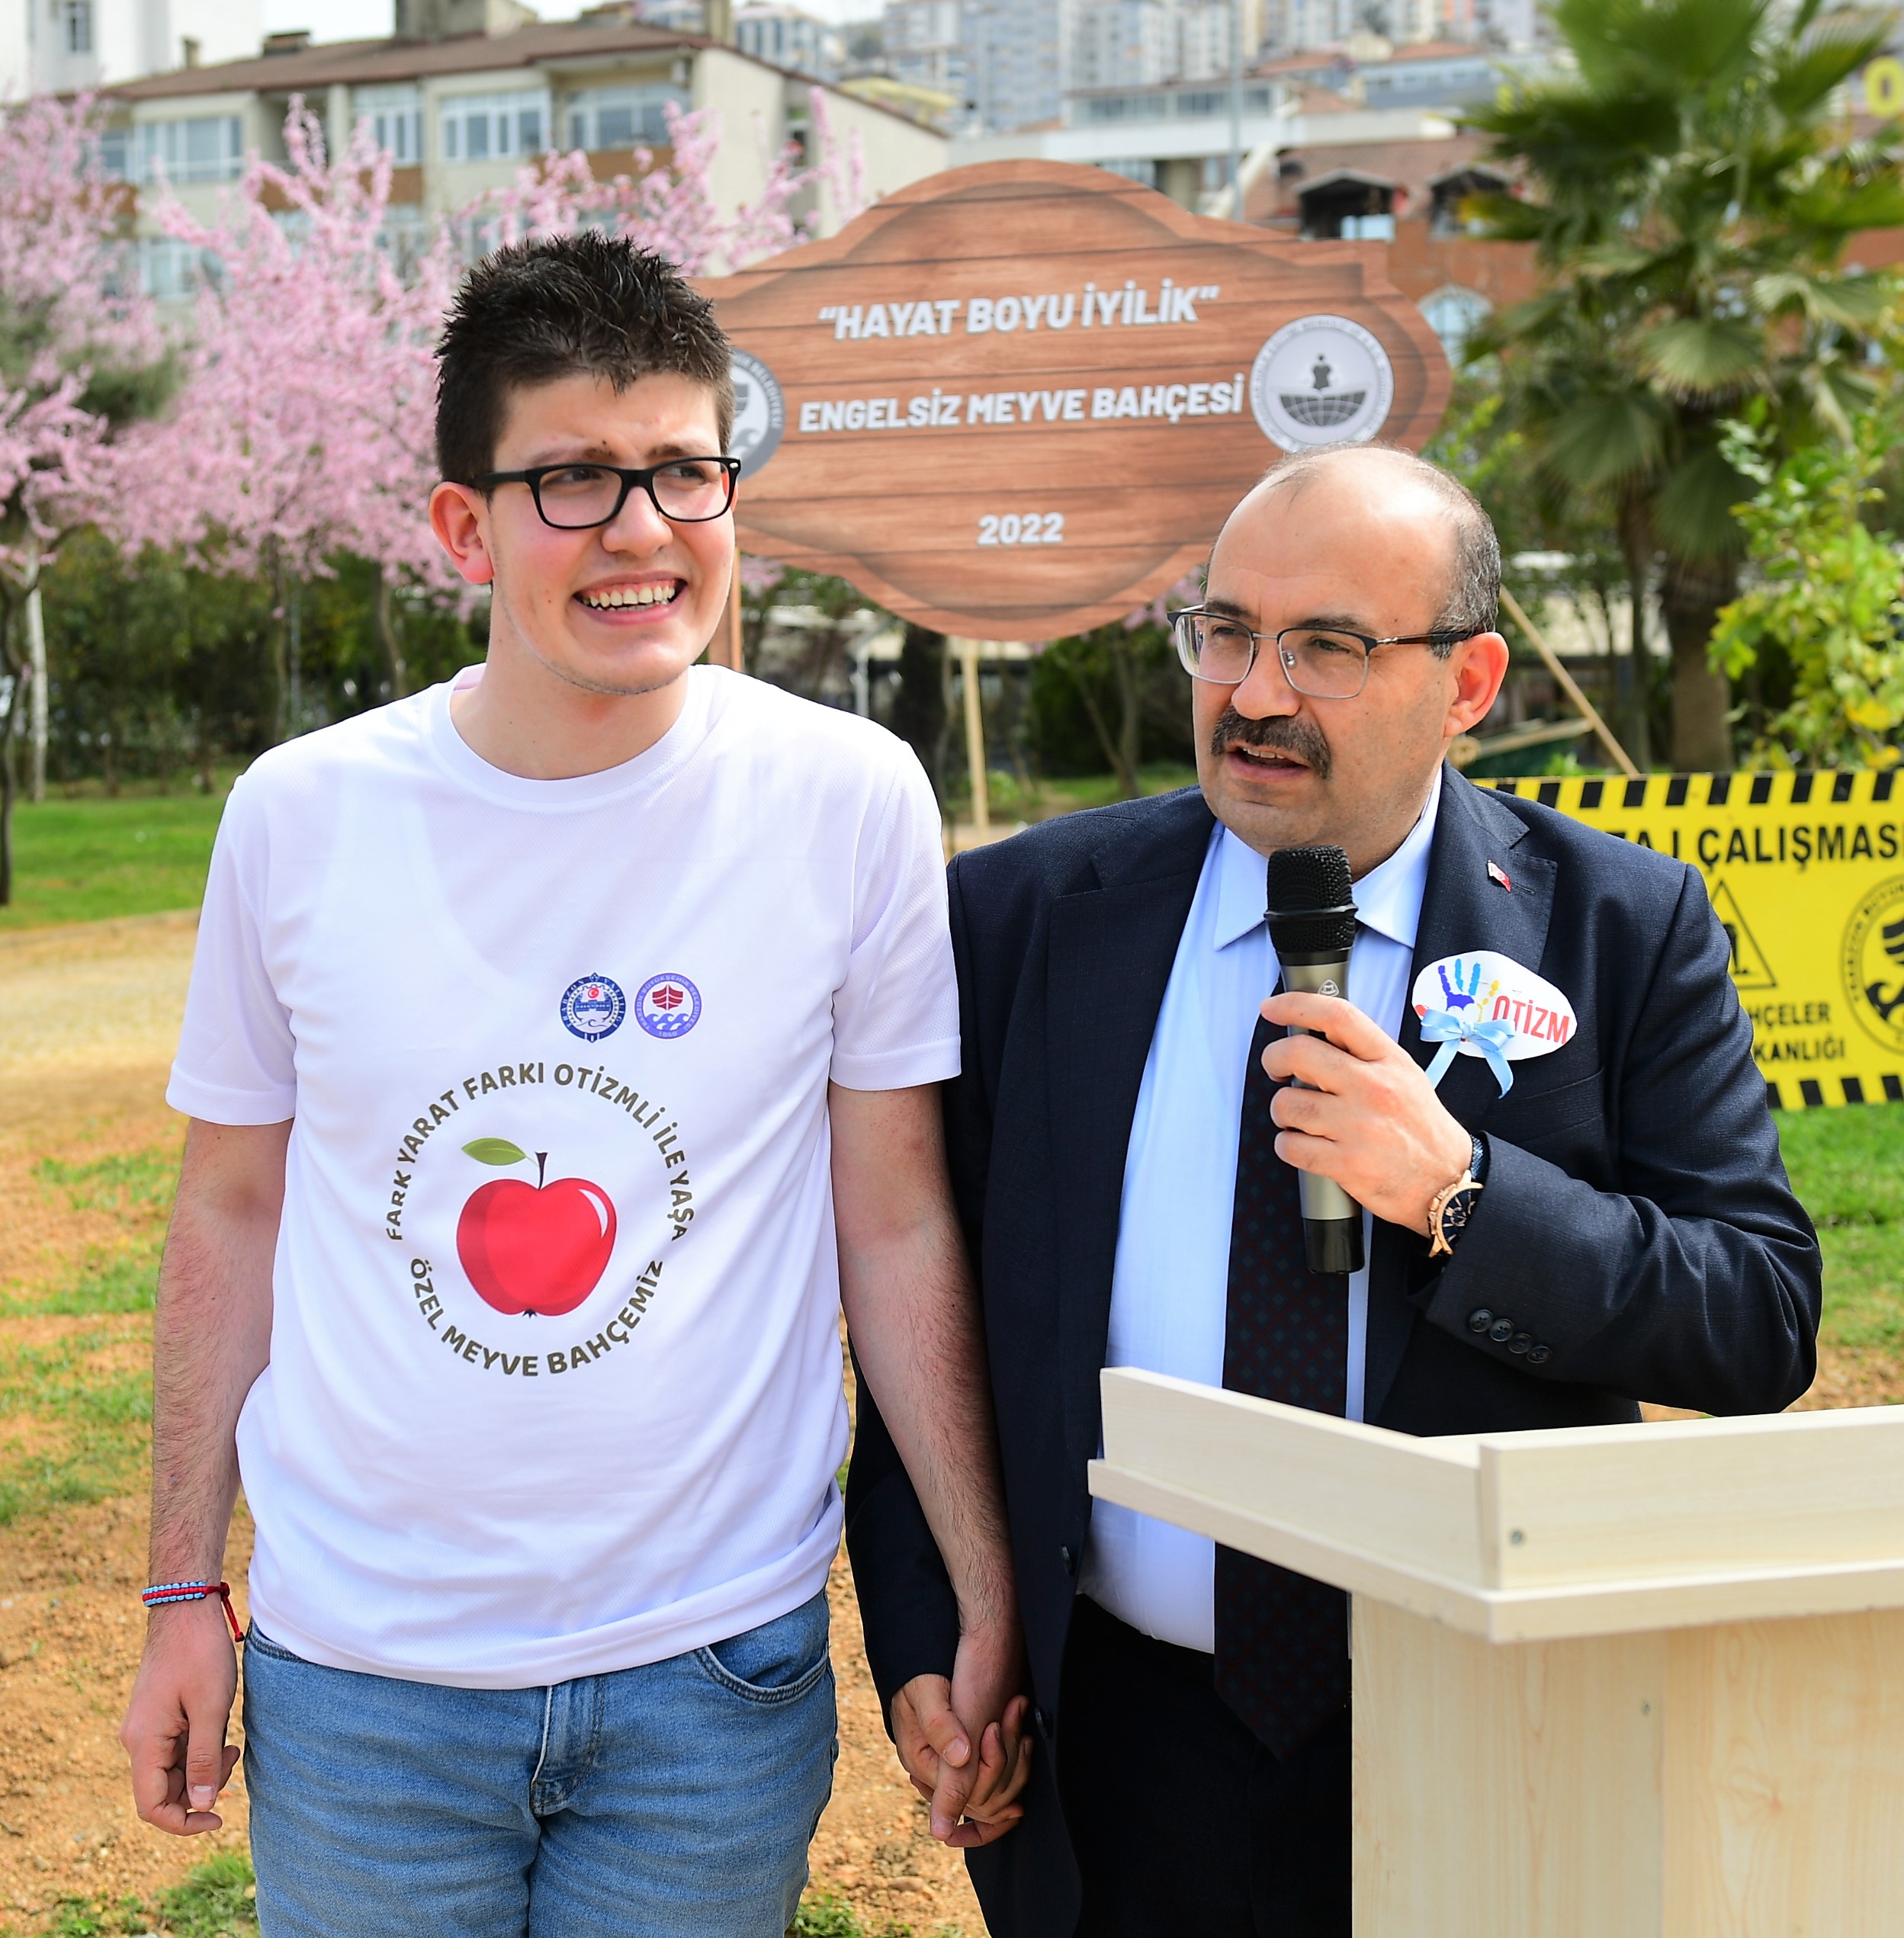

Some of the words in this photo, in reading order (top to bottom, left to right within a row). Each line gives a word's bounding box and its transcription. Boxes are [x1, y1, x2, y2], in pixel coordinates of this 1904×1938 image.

[966, 294, 1075, 334] BOYU
[799, 387, 963, 433] ENGELSİZ
[966, 387, 1087, 425] MEYVE
[1090, 371, 1246, 424] BAHÇESİ
[977, 511, 1065, 546] 2022
[1697, 823, 1904, 875] ÇALIŞMAS
[1492, 995, 1571, 1044] OTİZM
[462, 1062, 544, 1101] FARKI
[554, 1064, 666, 1130] OTİZMLİ
[397, 1089, 459, 1164] YARAT
[652, 1121, 686, 1170] İLE
[386, 1170, 412, 1240] FARK
[666, 1170, 695, 1242] YAŞA
[410, 1258, 445, 1330] ÖZEL
[441, 1325, 538, 1377] MEYVE
[547, 1259, 663, 1375] BAHÇEMİZ
